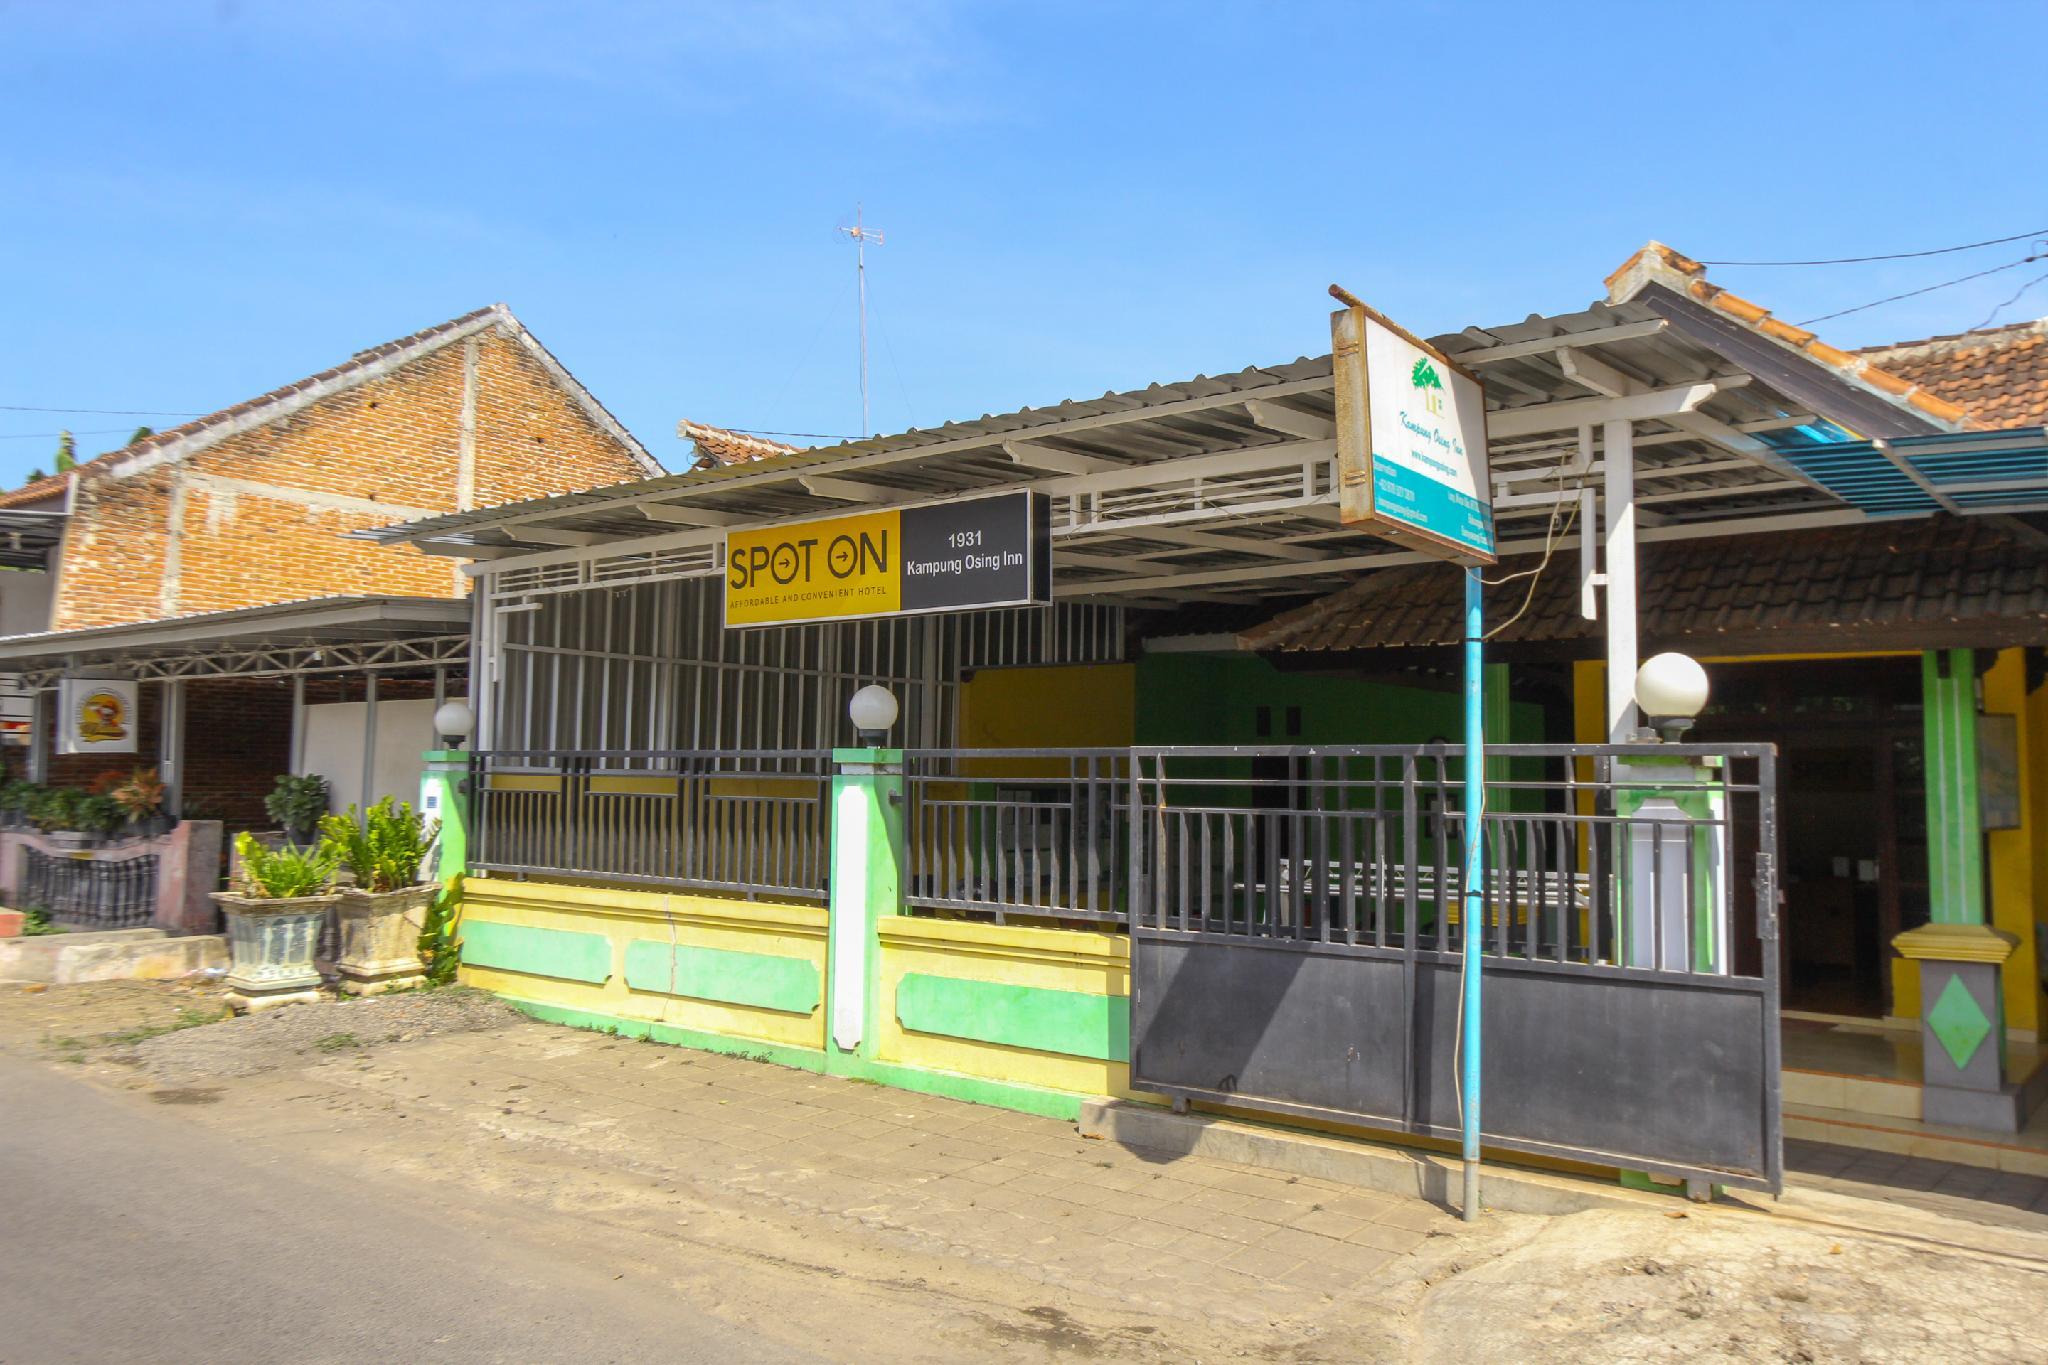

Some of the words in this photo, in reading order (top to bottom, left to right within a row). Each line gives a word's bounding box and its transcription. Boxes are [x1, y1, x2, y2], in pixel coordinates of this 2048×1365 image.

[948, 530, 982, 548] 1931
[730, 539, 818, 589] SPOT
[827, 529, 888, 579] ON
[907, 559, 962, 577] Kampung
[965, 553, 1000, 571] Osing
[1003, 550, 1023, 566] Inn
[730, 595, 779, 609] AFFORDABLE
[782, 593, 799, 603] AND
[801, 588, 854, 602] CONVENIENT
[858, 586, 887, 596] HOTEL
